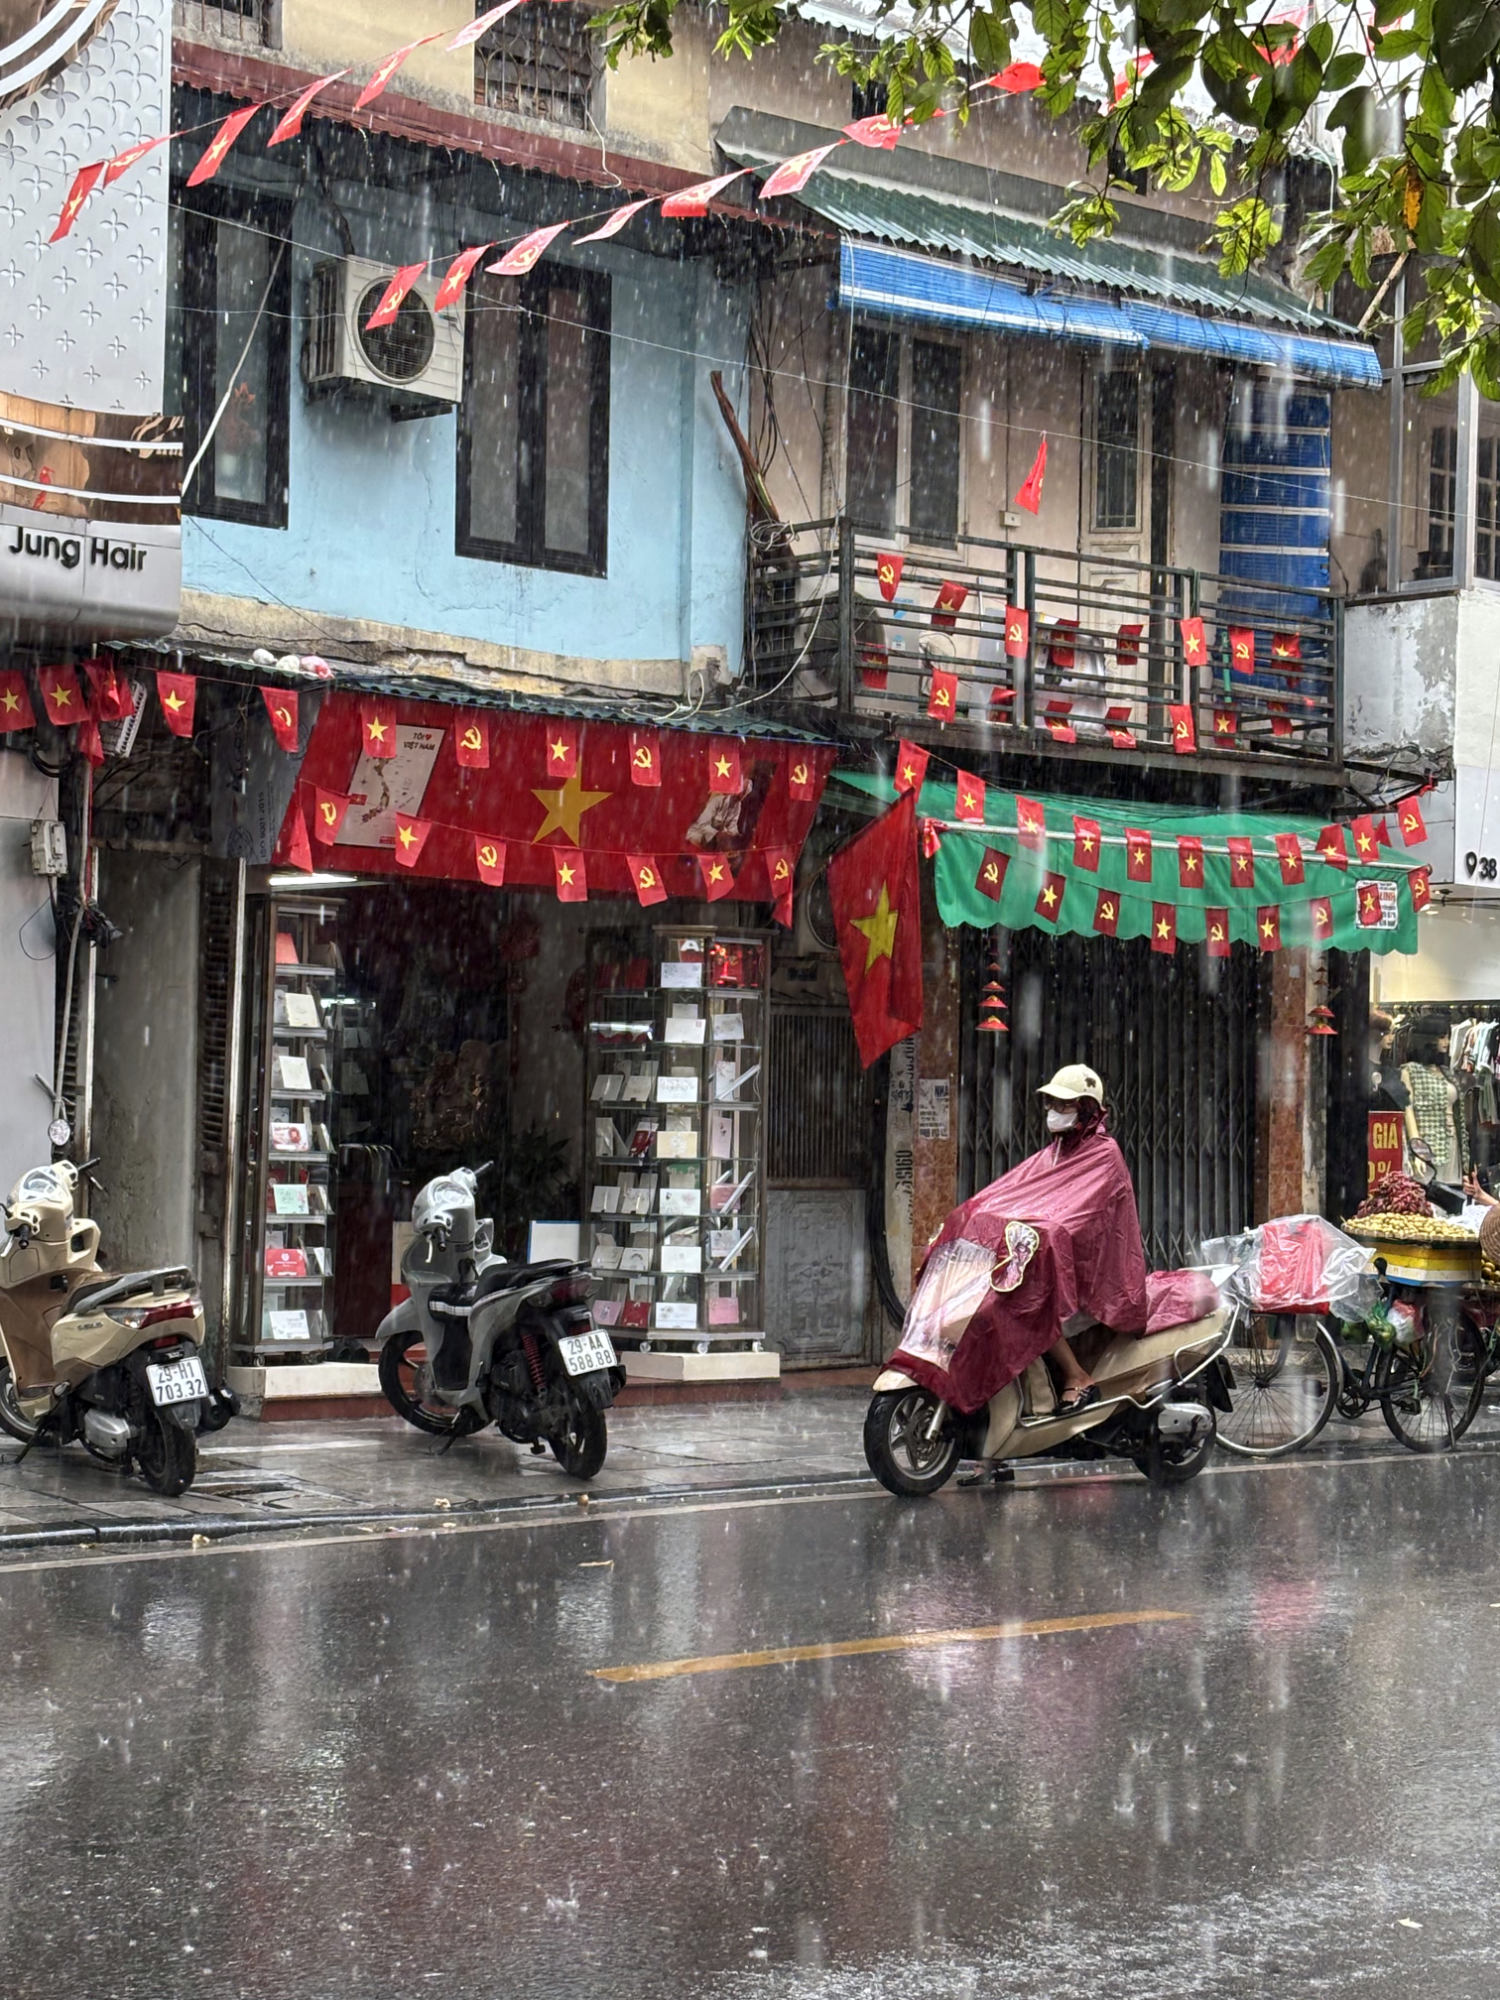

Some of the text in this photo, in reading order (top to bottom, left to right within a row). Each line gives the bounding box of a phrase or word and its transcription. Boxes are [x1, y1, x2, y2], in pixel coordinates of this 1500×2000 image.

[9, 526, 147, 572] Jung Hair
[1479, 857, 1497, 880] 38
[1373, 1117, 1399, 1149] GIÁ
[567, 1334, 604, 1356] 29-AA
[568, 1350, 612, 1372] 588.88
[158, 1362, 195, 1384] 29-H1
[155, 1379, 205, 1402] 703.32
